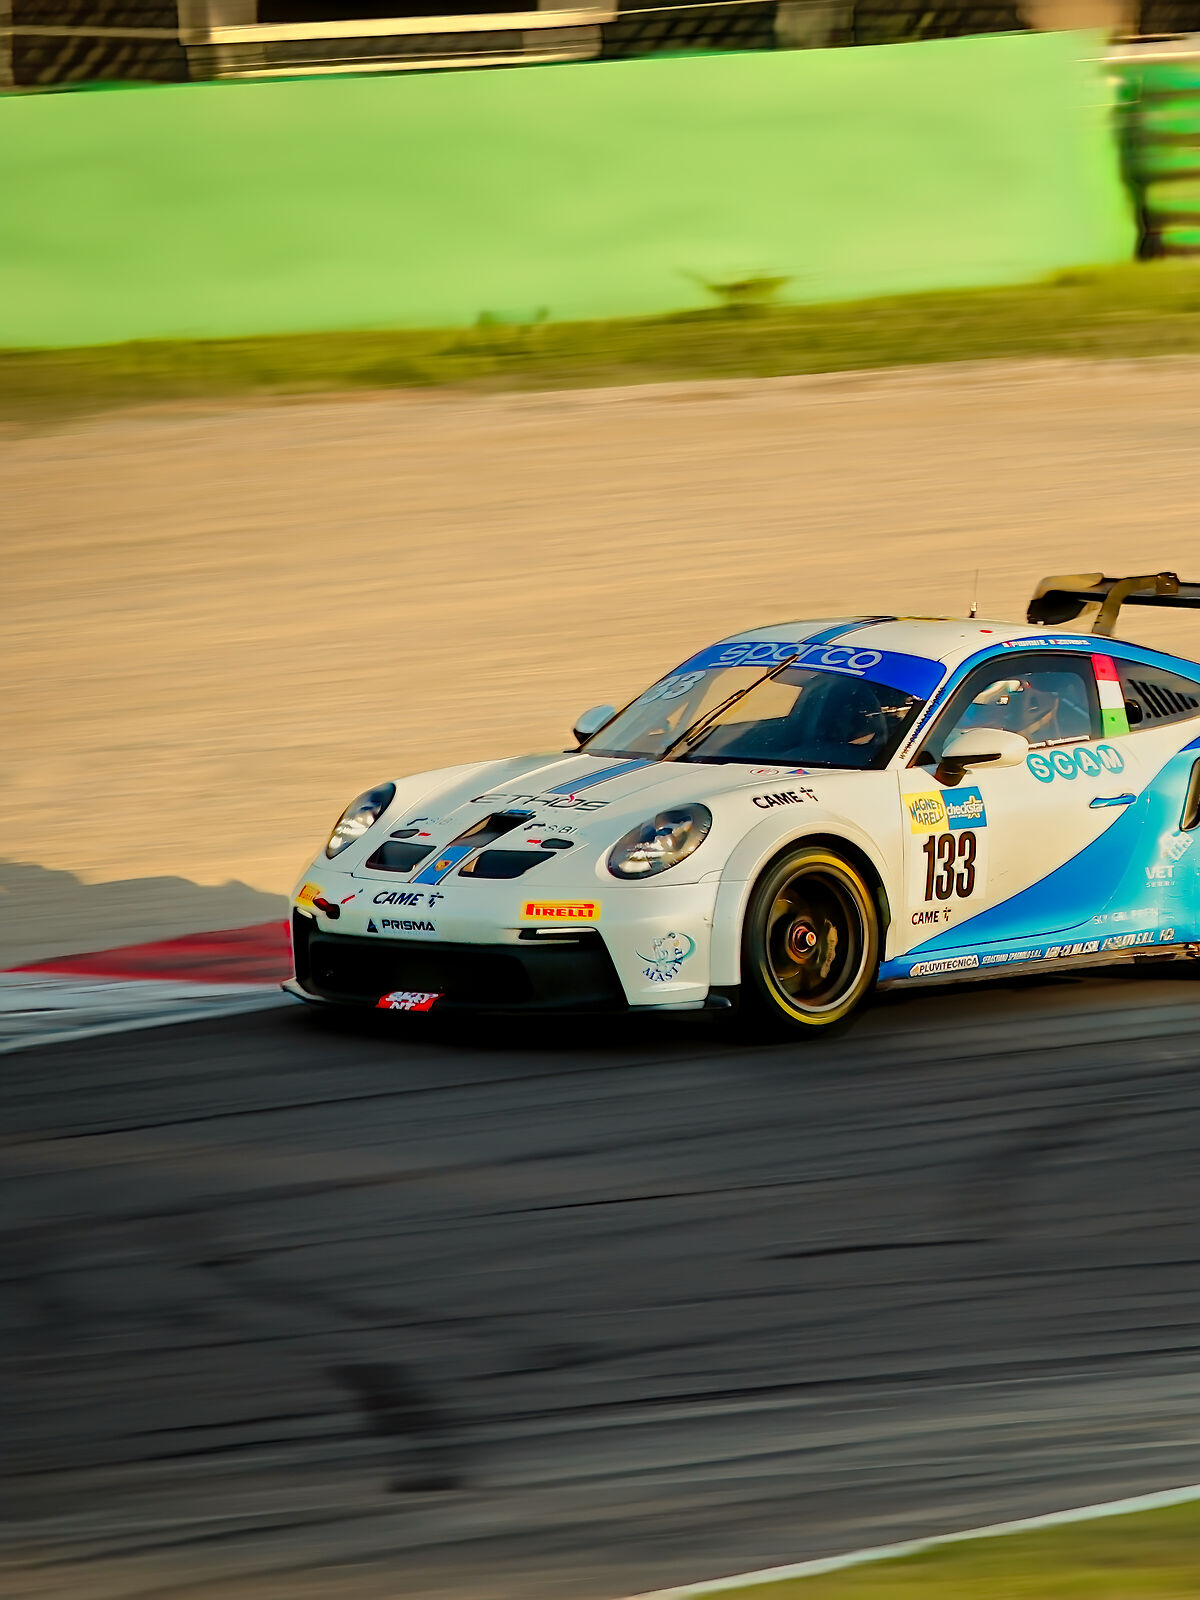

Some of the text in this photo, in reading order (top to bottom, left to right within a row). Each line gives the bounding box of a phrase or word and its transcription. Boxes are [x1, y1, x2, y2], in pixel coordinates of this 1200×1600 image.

[719, 643, 883, 670] sparco
[1029, 747, 1124, 780] SCAM
[470, 793, 611, 811] ETHOS
[752, 791, 804, 809] CAME
[922, 831, 976, 901] 133
[1145, 865, 1175, 880] VET
[372, 891, 424, 906] CAME
[526, 903, 595, 918] PIRELLI
[911, 910, 939, 925] CAME
[381, 919, 436, 931] PRISMA
[919, 957, 978, 973] PLUVITECNICA
